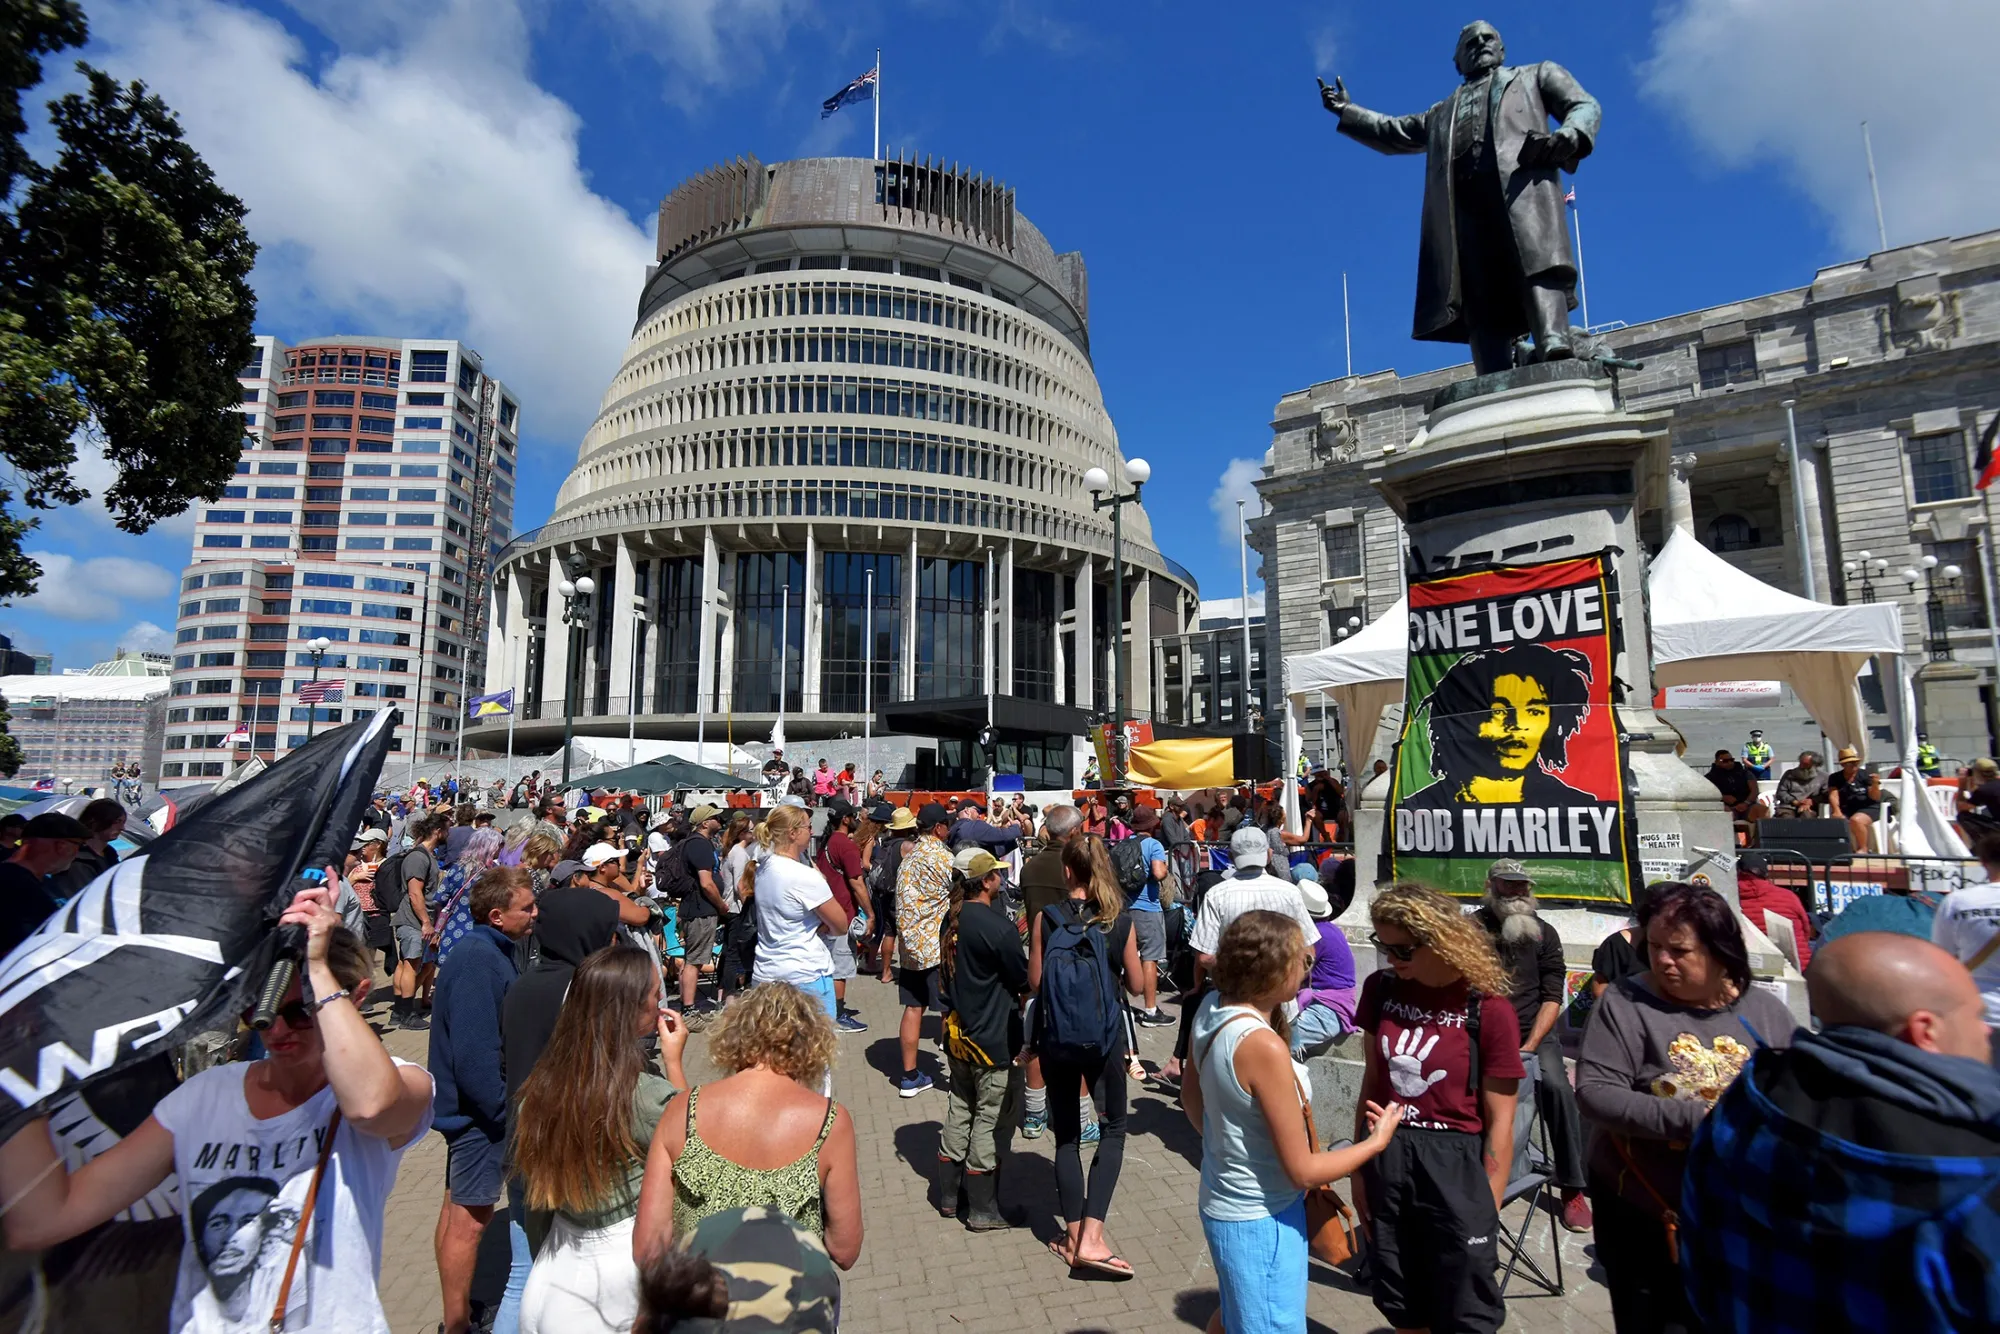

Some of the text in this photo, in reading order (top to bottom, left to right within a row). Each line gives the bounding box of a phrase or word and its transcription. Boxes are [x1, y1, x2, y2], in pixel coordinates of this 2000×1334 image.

[1410, 586, 1603, 652] ONE LOVE
[1396, 807, 1617, 855] BOB MARLEY
[1648, 841, 1680, 849] HEALTHY
[1667, 833, 1680, 841] ARE
[1383, 999, 1468, 1029] HANDS OFF
